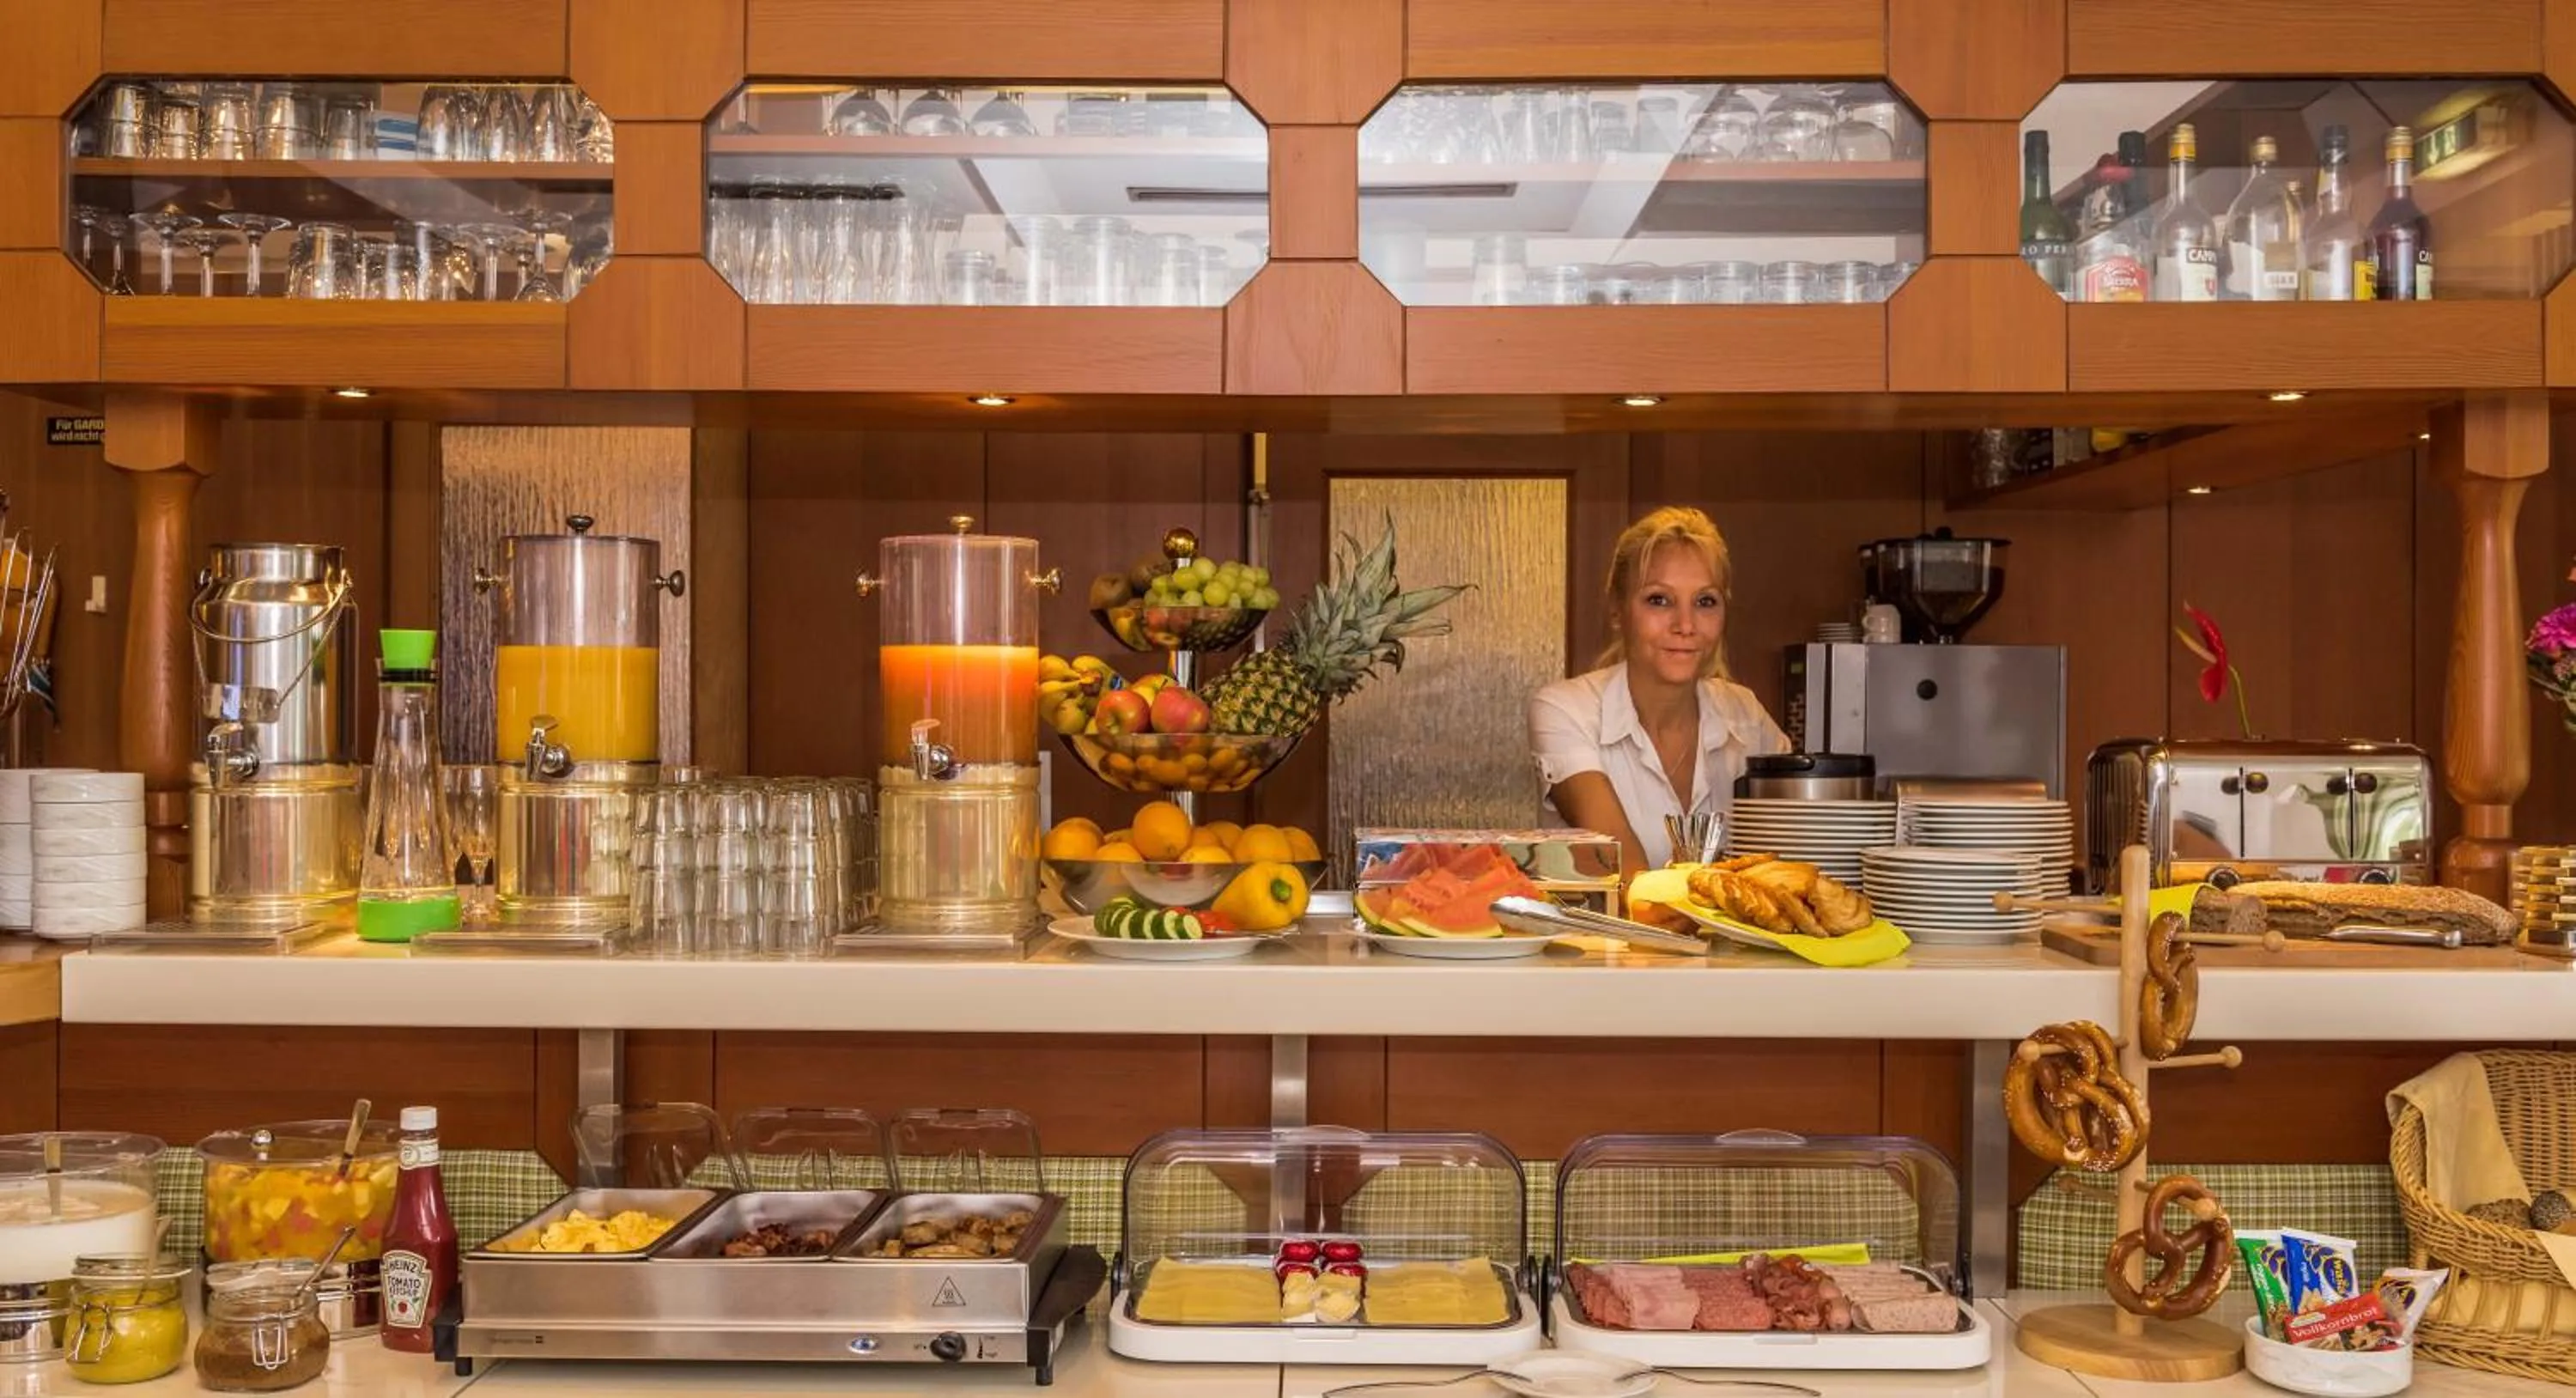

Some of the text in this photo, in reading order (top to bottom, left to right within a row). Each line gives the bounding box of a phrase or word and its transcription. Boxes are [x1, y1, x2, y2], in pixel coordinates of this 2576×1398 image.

[2189, 249, 2216, 263] CAMP
[52, 430, 73, 441] wird
[74, 430, 99, 441] nicht
[389, 1260, 417, 1273] HEINZ
[388, 1275, 421, 1289] TOMATO
[2292, 1307, 2378, 1337] Vollkornbrot
